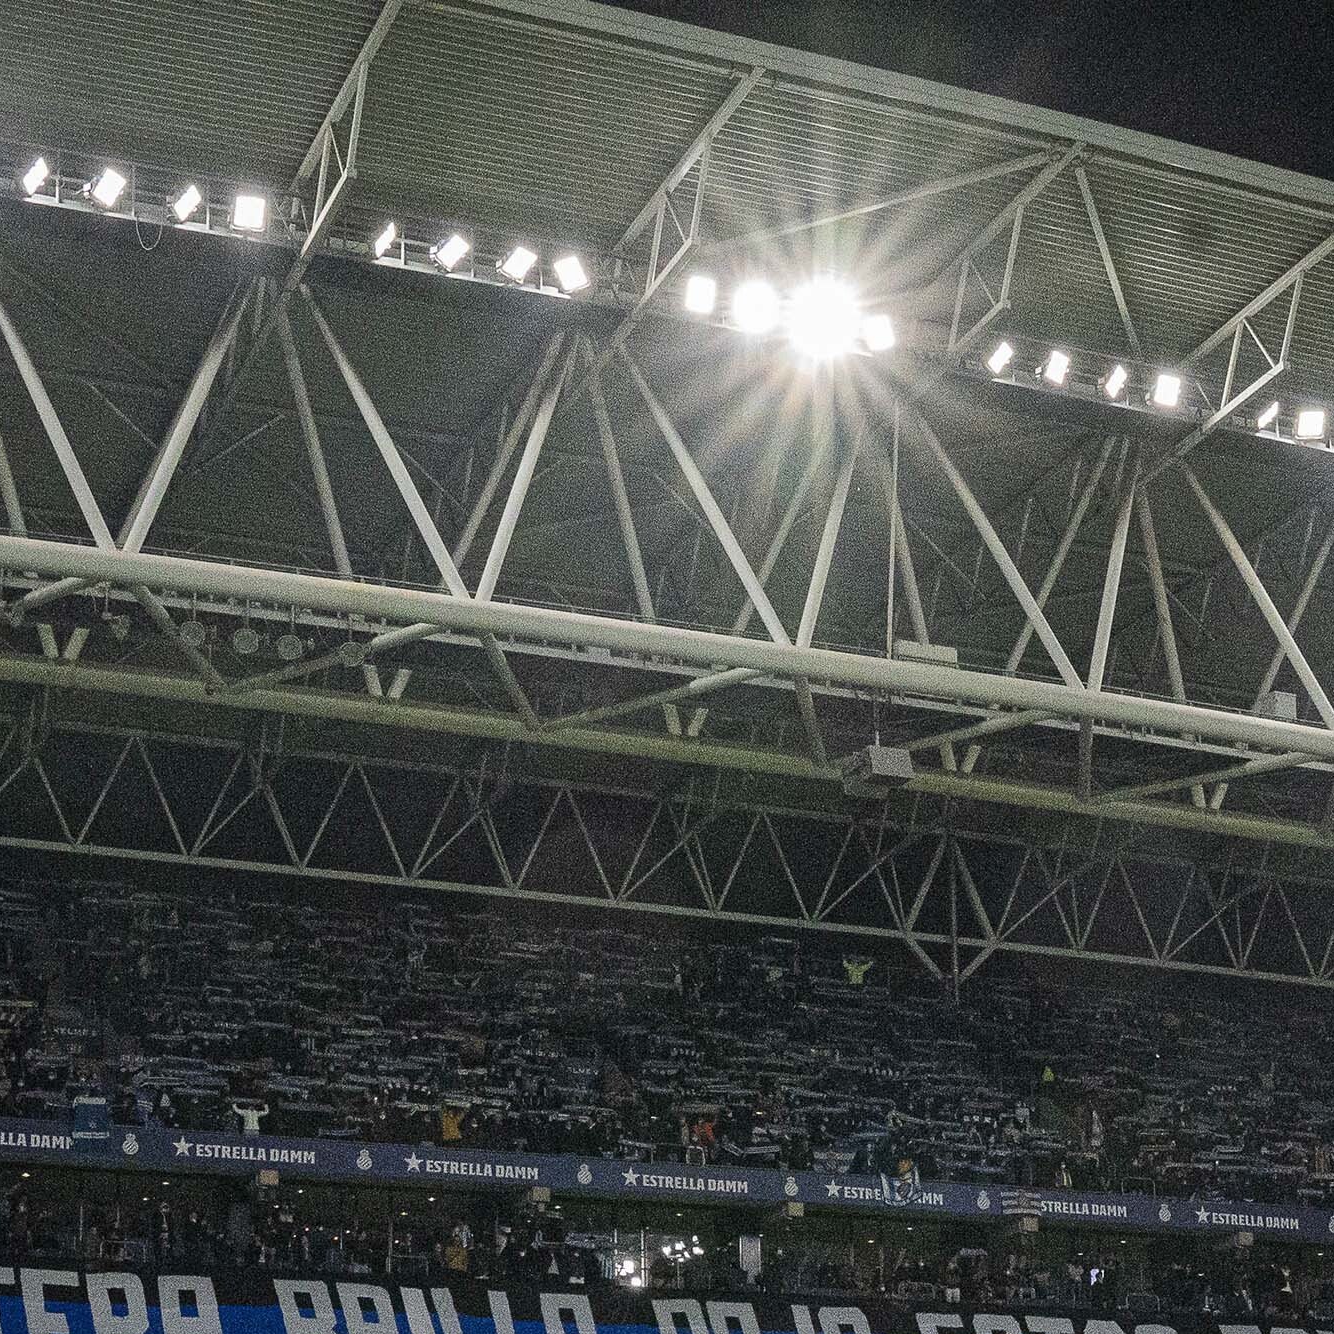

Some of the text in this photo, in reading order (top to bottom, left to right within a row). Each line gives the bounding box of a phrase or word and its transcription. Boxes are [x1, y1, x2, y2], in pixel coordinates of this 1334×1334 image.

[195, 1144, 316, 1166] ESTRELLA DAMM
[425, 1159, 539, 1180] ESTRELLA DAMM
[642, 1172, 749, 1195] ESTRELLA DAMM
[1040, 1200, 1127, 1218] STRELLA DAMM
